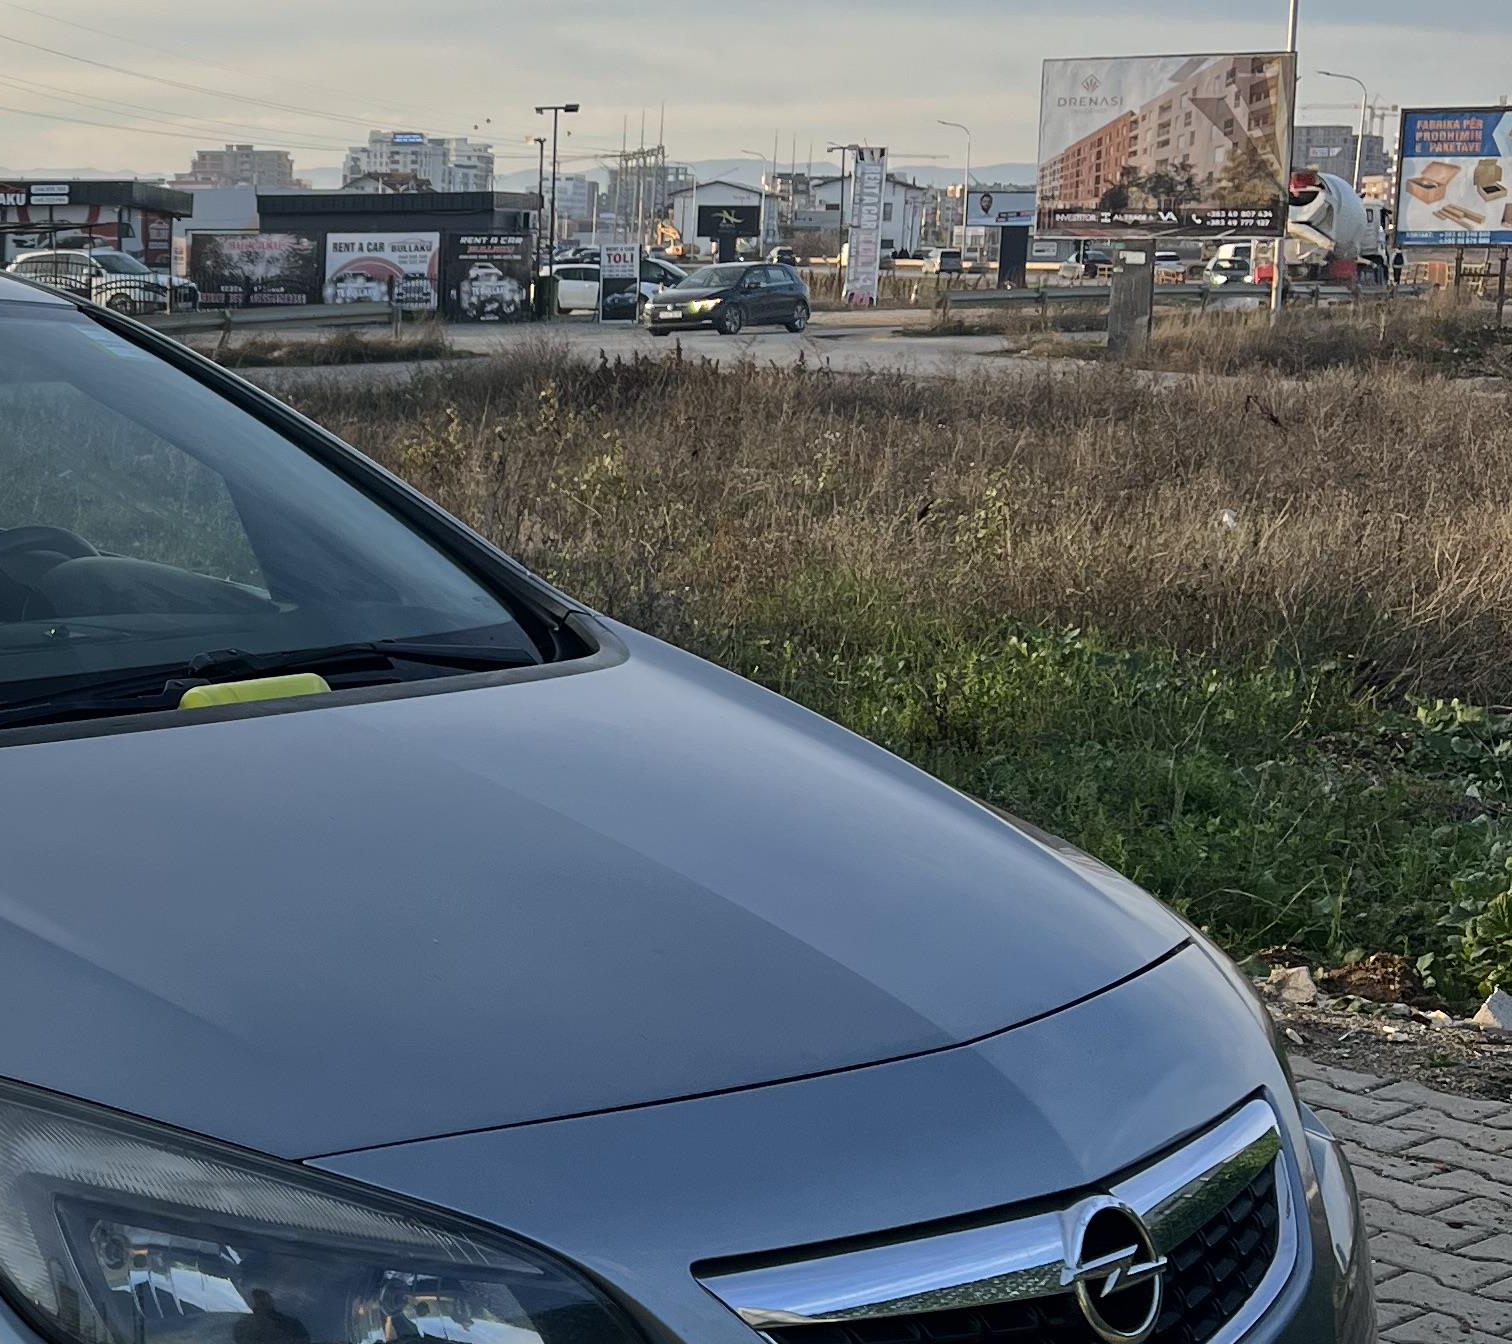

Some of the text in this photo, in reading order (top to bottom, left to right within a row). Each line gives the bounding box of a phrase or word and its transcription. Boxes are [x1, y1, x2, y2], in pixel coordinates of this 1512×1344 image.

[1057, 96, 1123, 107] DRENASI
[1417, 119, 1460, 130] FABRIKA
[460, 236, 488, 245] RENT
[332, 242, 432, 253] RENT A CAR BULLAKU
[606, 253, 634, 264] TOLI
